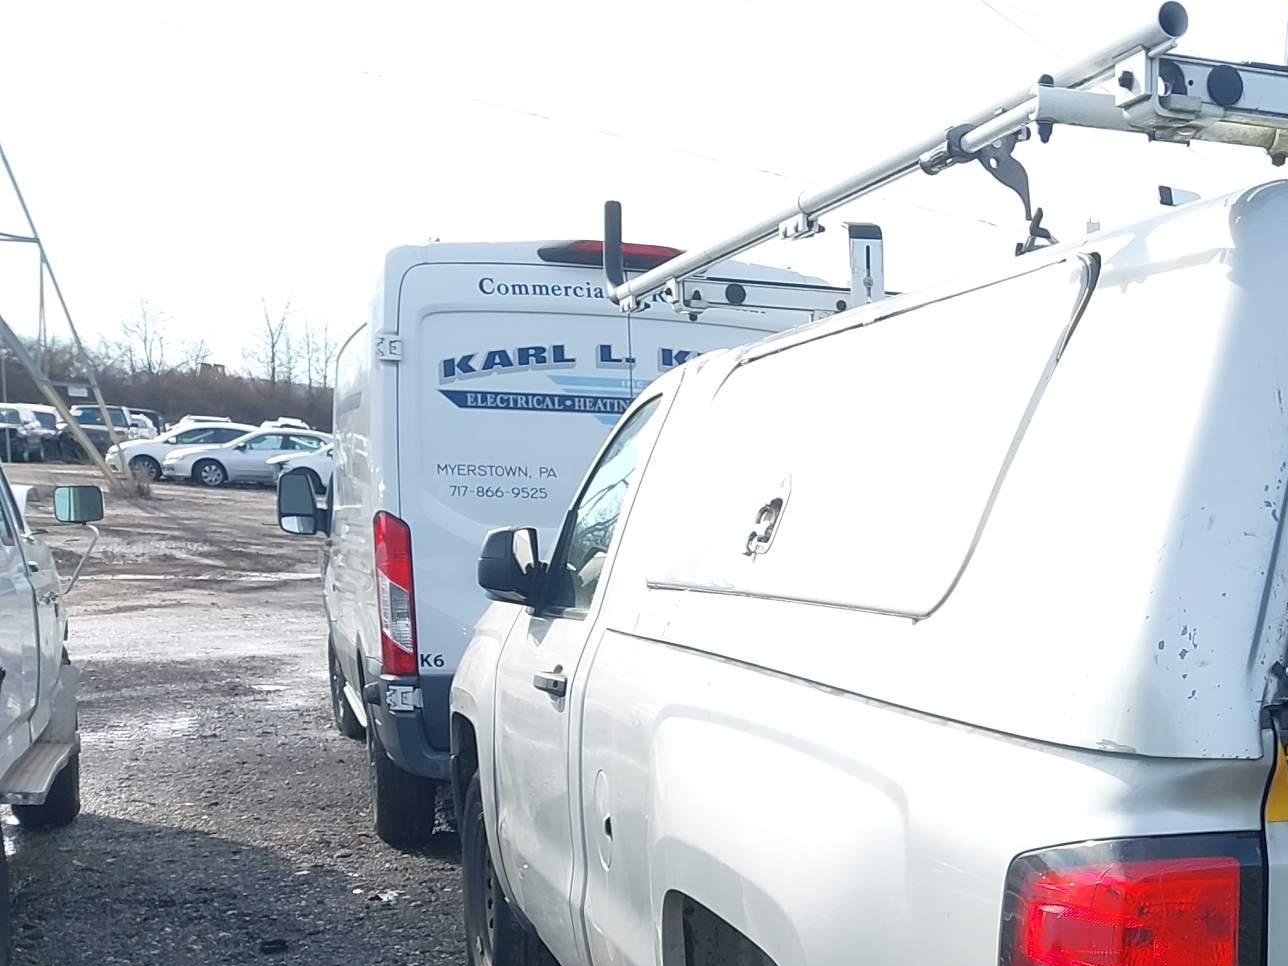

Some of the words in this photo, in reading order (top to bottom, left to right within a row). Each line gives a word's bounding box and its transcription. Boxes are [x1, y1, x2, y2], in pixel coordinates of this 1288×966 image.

[441, 344, 576, 381] KARL
[598, 344, 636, 365] L.
[574, 397, 630, 413] HEATIN
[539, 466, 557, 479] PA
[449, 485, 549, 500] 717-866-9525
[420, 653, 445, 668] K6
